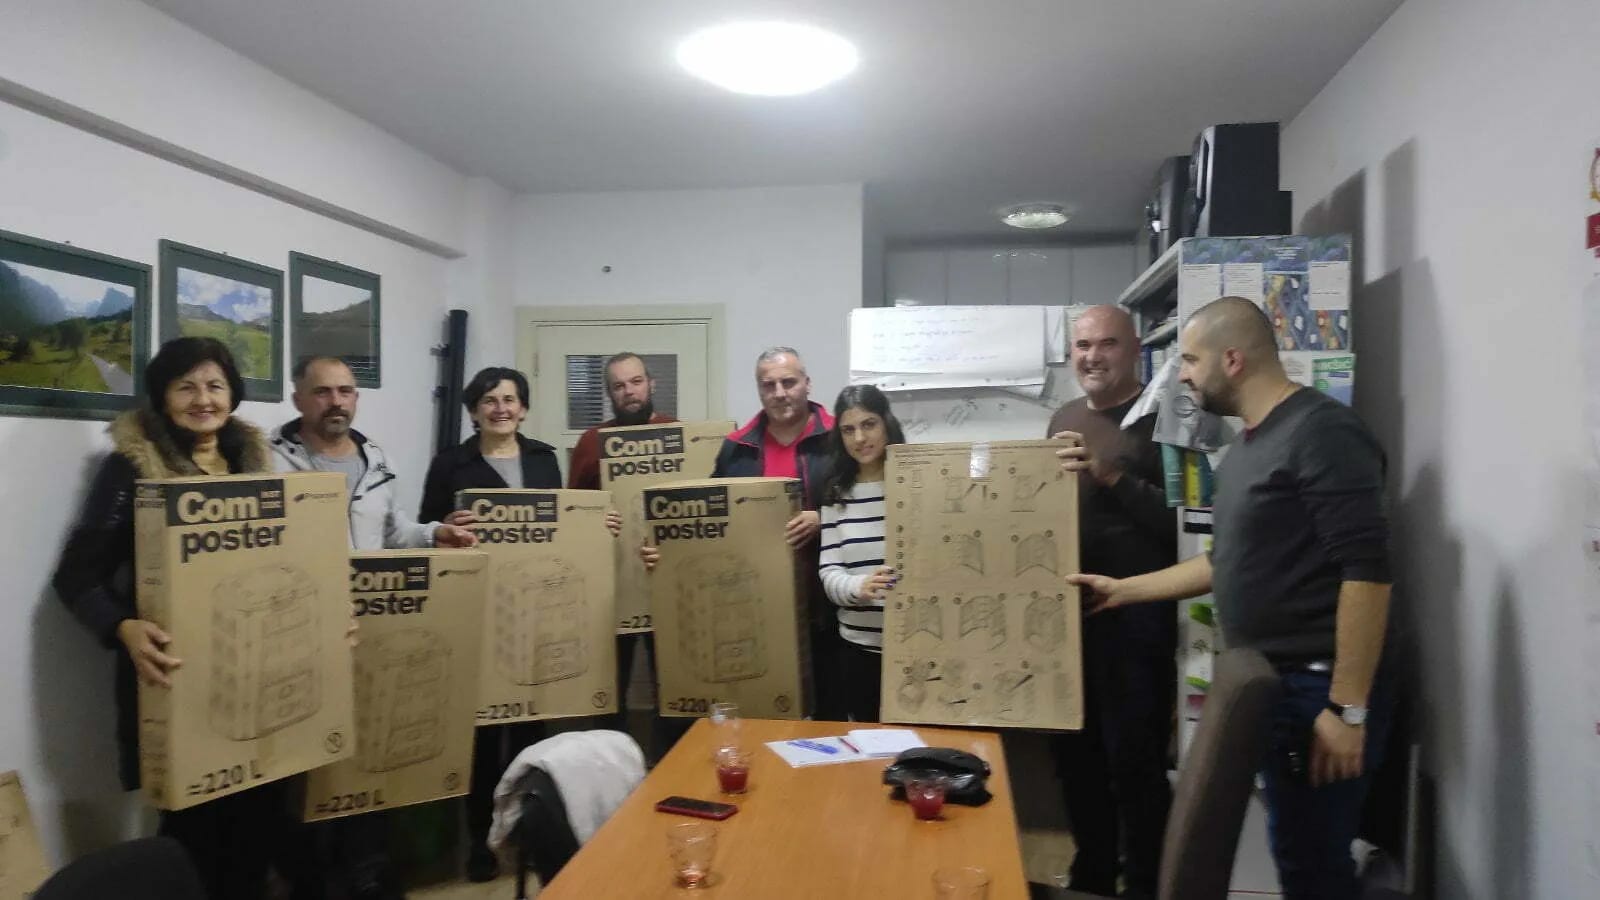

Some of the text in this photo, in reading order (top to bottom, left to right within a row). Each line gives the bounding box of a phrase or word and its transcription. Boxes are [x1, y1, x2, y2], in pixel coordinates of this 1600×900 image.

[604, 436, 664, 457] Com
[607, 455, 685, 481] poster
[176, 491, 260, 523] Com
[471, 499, 535, 522] Com
[649, 496, 708, 518] Com
[180, 522, 287, 563] poster
[653, 519, 729, 545] poster
[351, 592, 429, 616] oster
[527, 701, 539, 717] L
[249, 760, 264, 780] L
[374, 788, 386, 806] L
